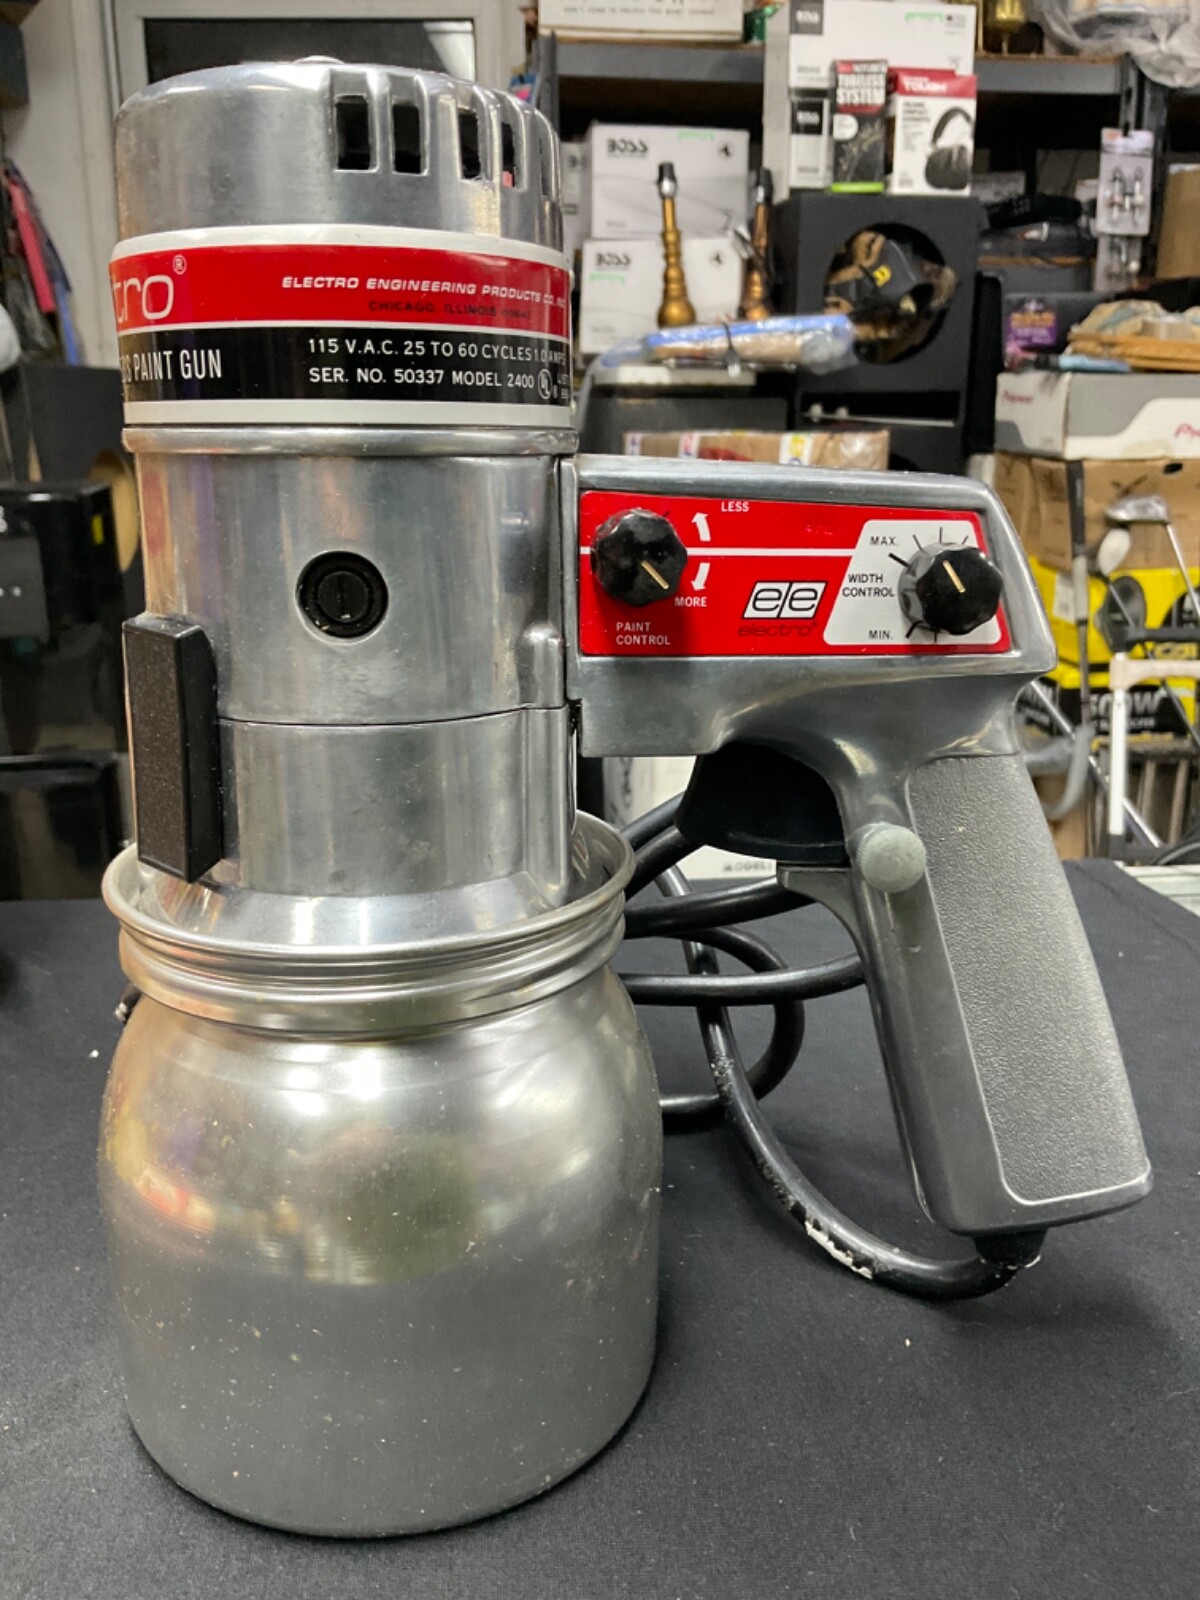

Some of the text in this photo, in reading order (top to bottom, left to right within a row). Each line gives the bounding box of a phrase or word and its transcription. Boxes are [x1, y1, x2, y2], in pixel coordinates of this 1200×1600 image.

[281, 275, 360, 289] ELECTRO
[366, 278, 476, 295] ENGINEERING
[482, 285, 541, 303] PRODUCTS
[308, 338, 339, 353] 115
[345, 339, 399, 355] V.A.C.
[404, 340, 425, 356] 25
[430, 341, 453, 357] TO
[458, 342, 478, 358] 60
[481, 344, 532, 361] CYCLES
[133, 350, 173, 381] PAINT
[180, 348, 222, 380] GUN
[308, 367, 535, 389] SER. NO. 50337 MODEL 2400
[721, 501, 750, 513] LESS
[869, 535, 900, 546] MAX.
[848, 573, 884, 584] WIDTH
[842, 587, 896, 598] CONTROL
[674, 596, 707, 608] MORE
[616, 622, 651, 632] PAINT
[616, 634, 671, 646] CONTROL
[868, 629, 894, 640] MIN.
